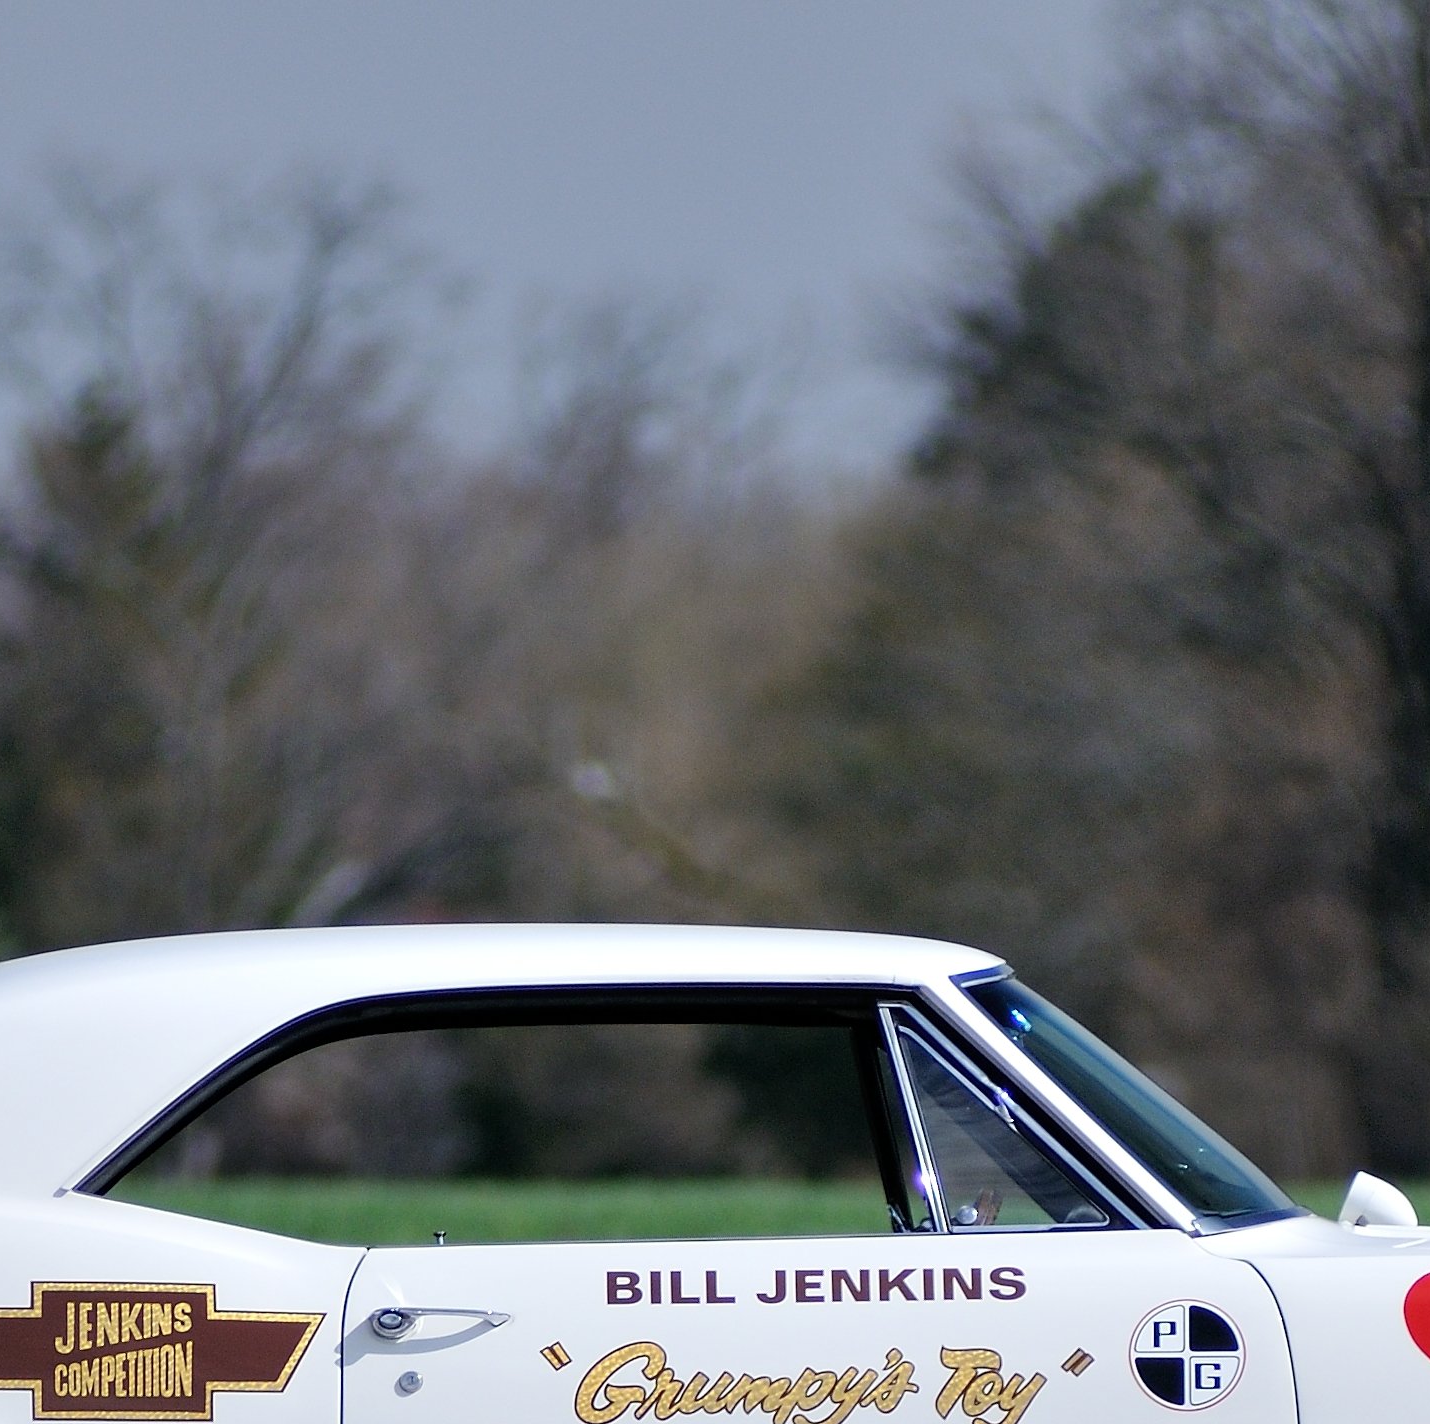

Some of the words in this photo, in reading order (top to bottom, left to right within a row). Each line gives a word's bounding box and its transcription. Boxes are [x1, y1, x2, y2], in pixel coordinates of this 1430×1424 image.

[606, 1271, 736, 1304] BILL
[757, 1267, 1028, 1303] JENKINS
[54, 1302, 193, 1354] JENKINS
[54, 1341, 194, 1397] COMPETITION
